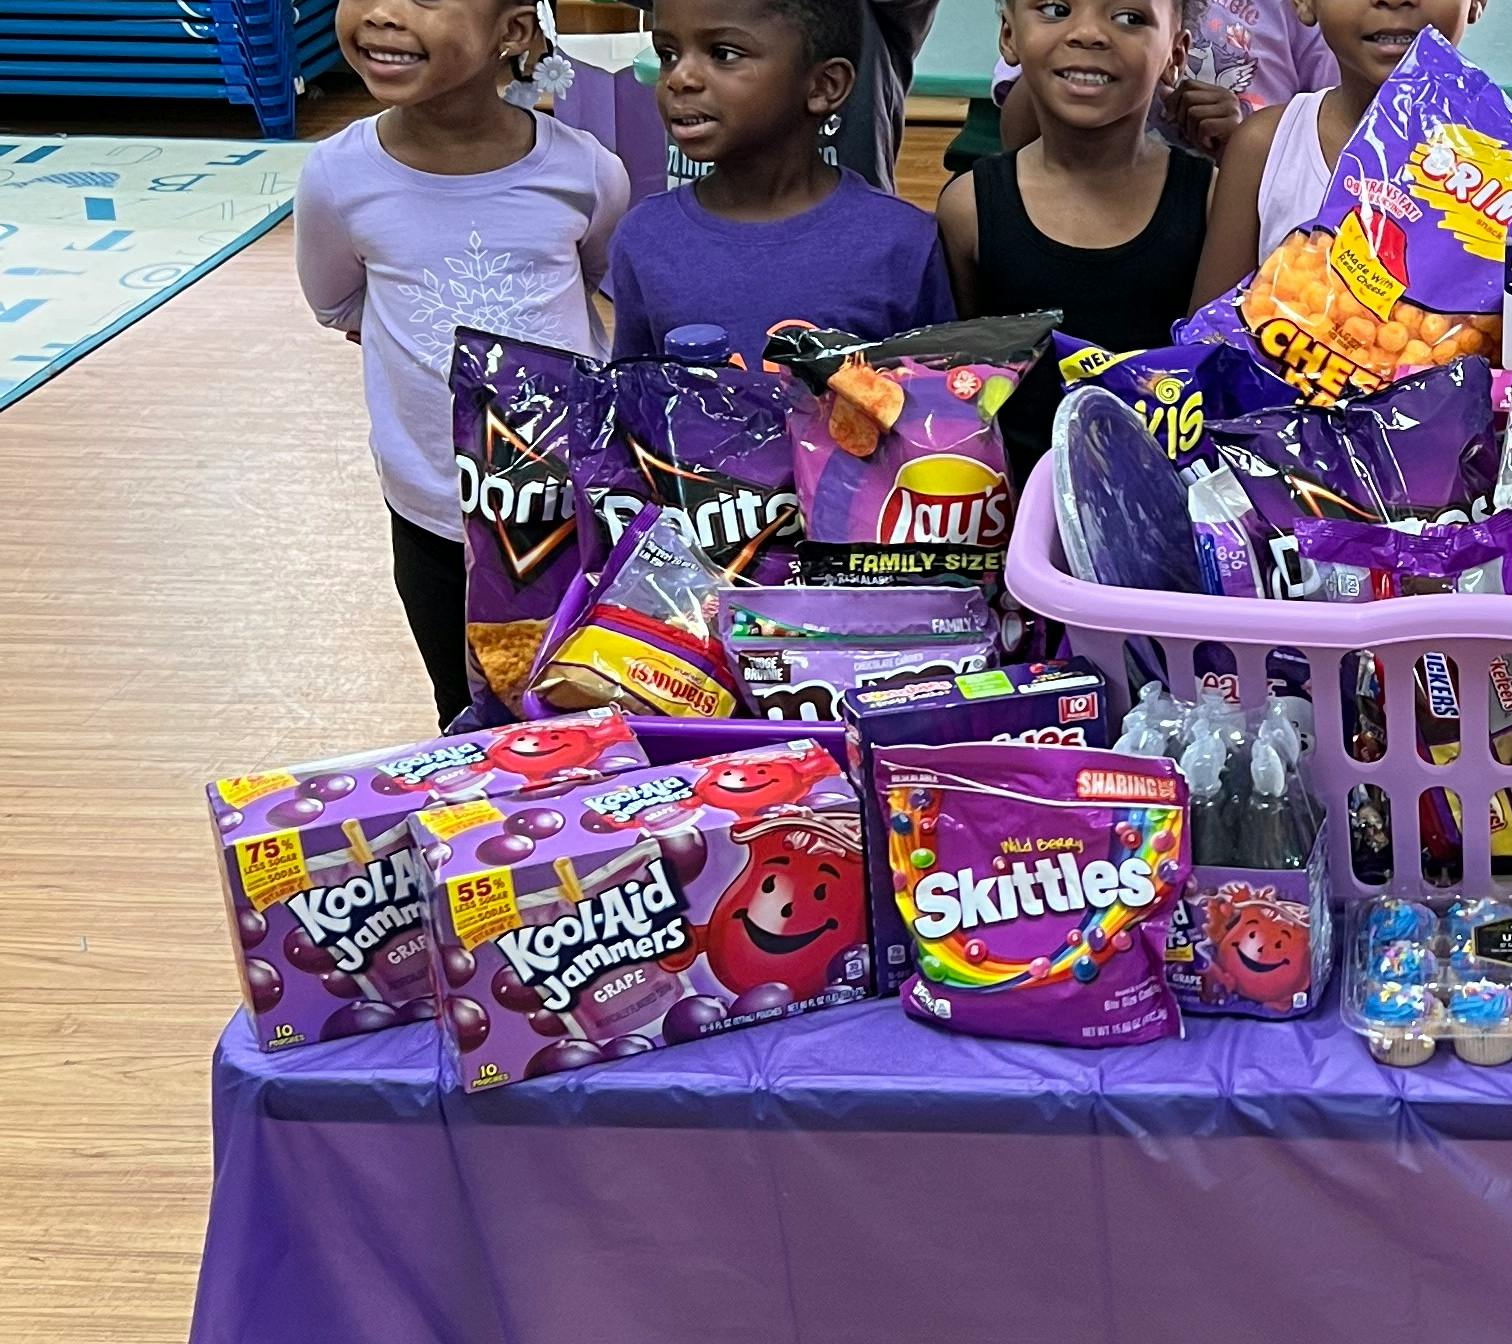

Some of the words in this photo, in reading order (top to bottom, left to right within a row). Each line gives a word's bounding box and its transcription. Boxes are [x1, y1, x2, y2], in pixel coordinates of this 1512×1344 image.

[1337, 253, 1357, 273] Real
[1356, 274, 1388, 297] Cheese
[1343, 249, 1371, 275] Made
[1371, 270, 1394, 291] With
[890, 484, 1007, 545] Lay's
[849, 553, 937, 573] FAMILY
[931, 618, 972, 633] FAMILY
[629, 661, 718, 716] Starburst
[1069, 697, 1087, 713] 10
[1080, 771, 1158, 796] SHARING
[245, 838, 281, 863] 75
[281, 839, 294, 851] %
[288, 848, 419, 942] Kool-A
[456, 876, 493, 902] 55
[493, 877, 506, 890] %
[914, 853, 1155, 940] Skittles
[335, 901, 426, 972] Jamm
[497, 859, 677, 983] Kool-Aid
[542, 918, 686, 1010] Jammers
[593, 969, 646, 1004] GRAPE
[275, 1024, 293, 1037] 10
[479, 1064, 498, 1078] 10
